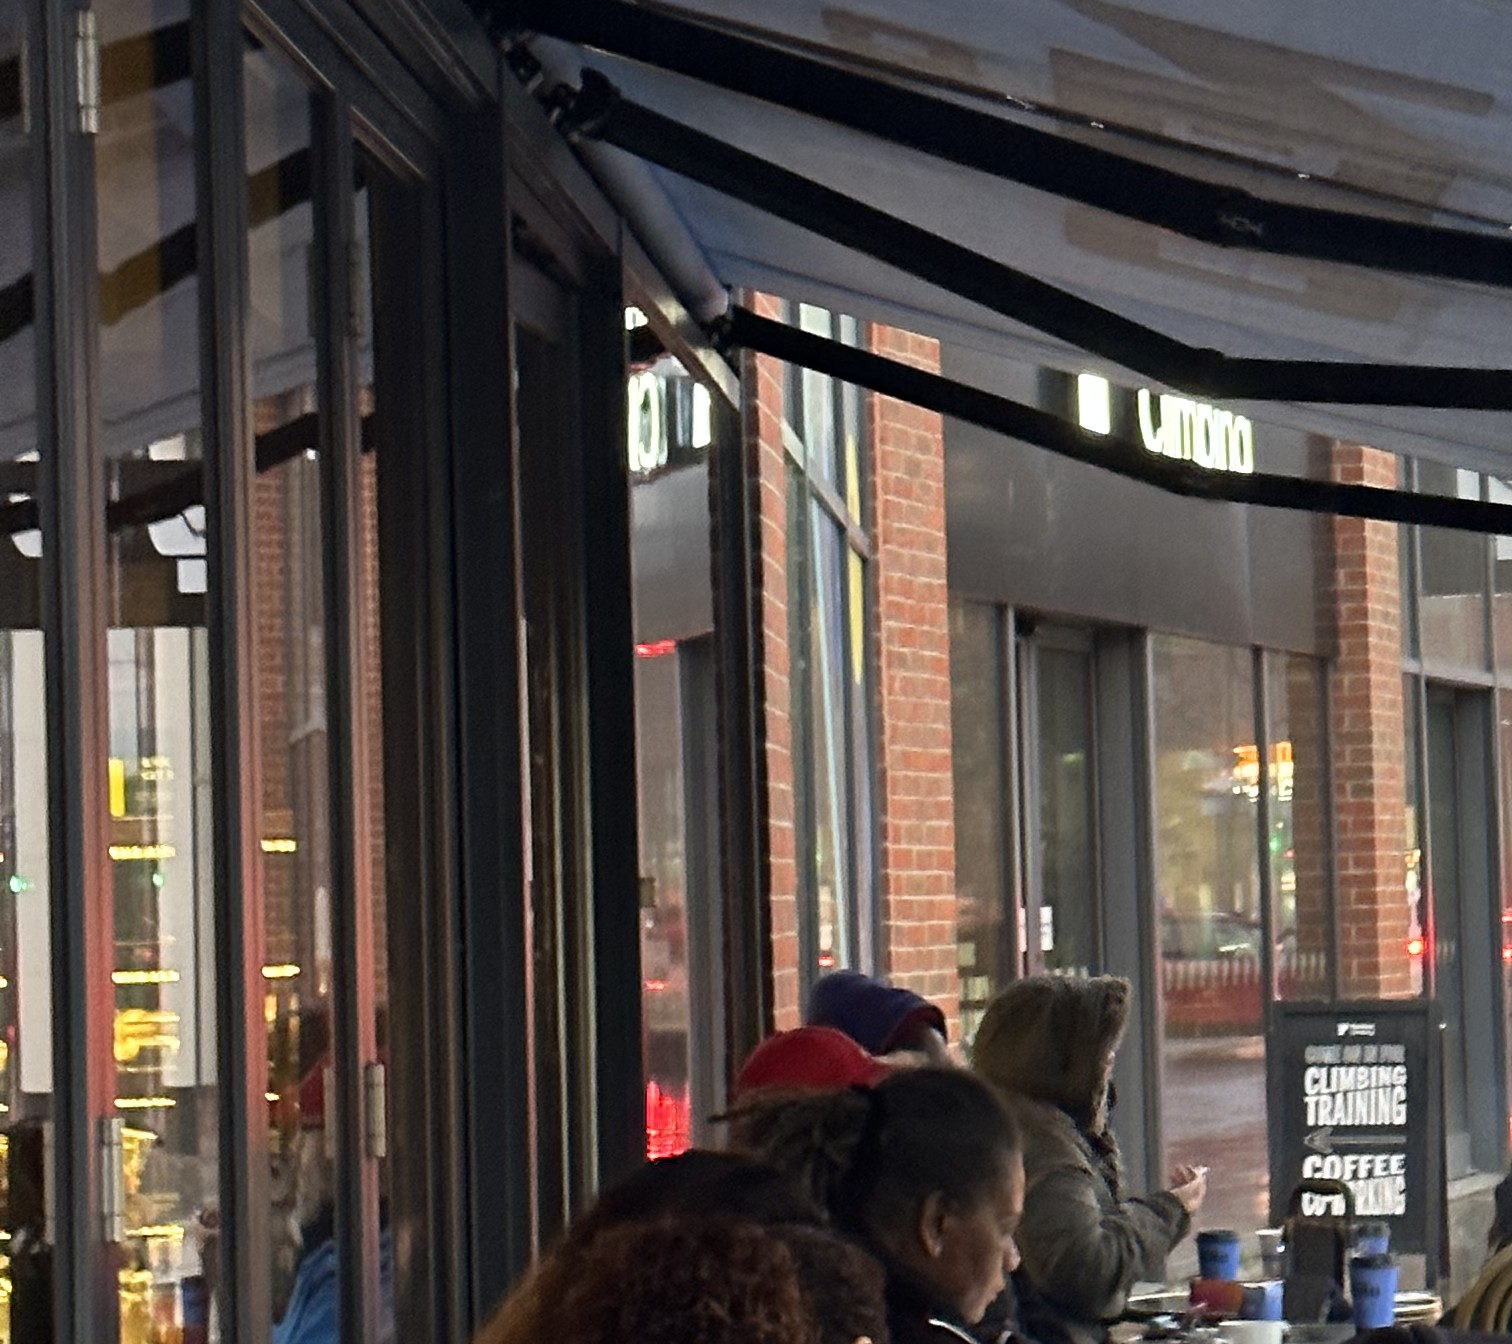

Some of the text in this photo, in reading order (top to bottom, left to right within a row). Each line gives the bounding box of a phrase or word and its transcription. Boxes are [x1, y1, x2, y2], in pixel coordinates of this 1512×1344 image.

[1304, 1065, 1407, 1095] CLIMBING
[1303, 1086, 1407, 1126] TRAINING
[1302, 1153, 1406, 1181] COFFEE
